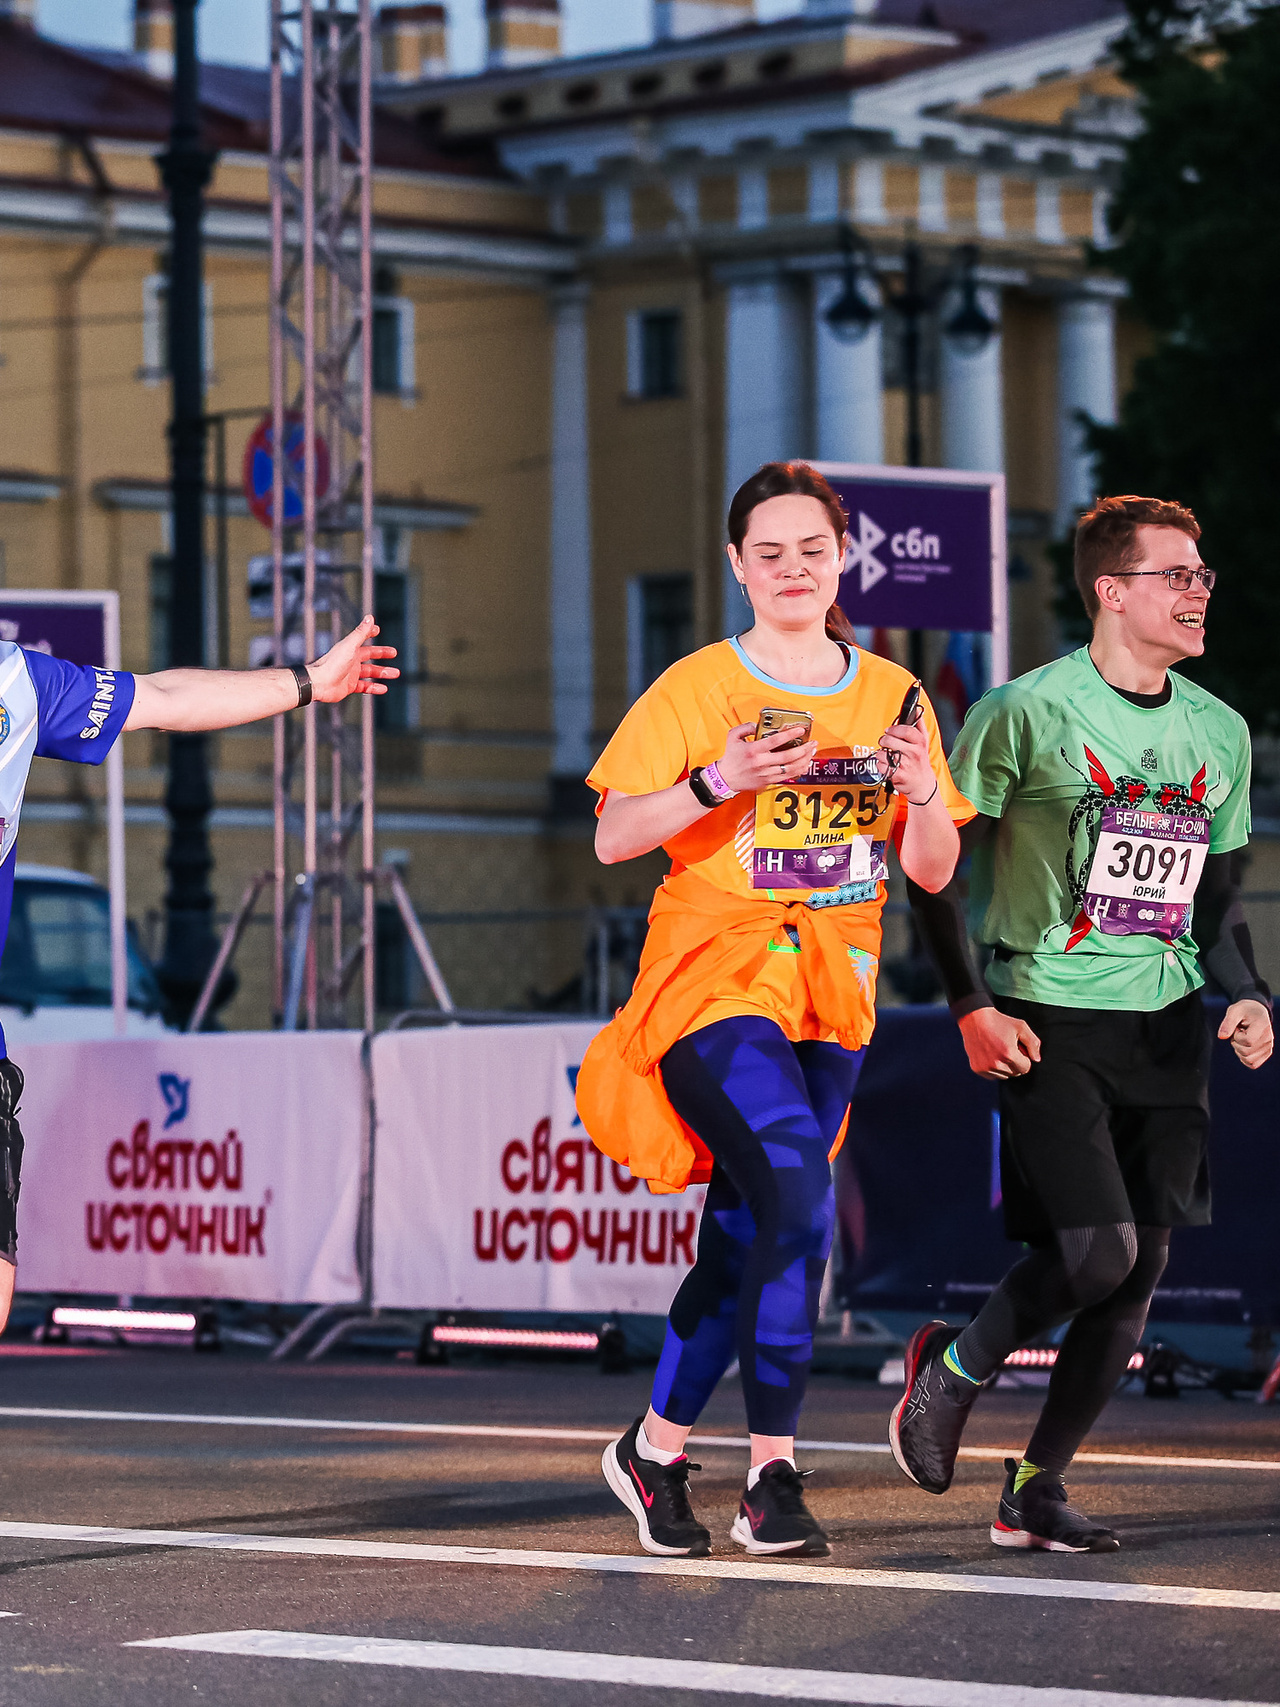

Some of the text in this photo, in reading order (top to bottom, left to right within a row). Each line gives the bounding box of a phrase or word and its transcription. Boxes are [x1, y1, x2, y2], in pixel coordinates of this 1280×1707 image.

[773, 790, 880, 830] 3125
[1116, 811, 1205, 836] БЕЛЫЕ НОЧИ
[804, 832, 845, 846] АЛИНА
[1107, 841, 1192, 885] 3091
[1132, 886, 1166, 899] ЮРИЙ
[500, 1117, 666, 1194] свято
